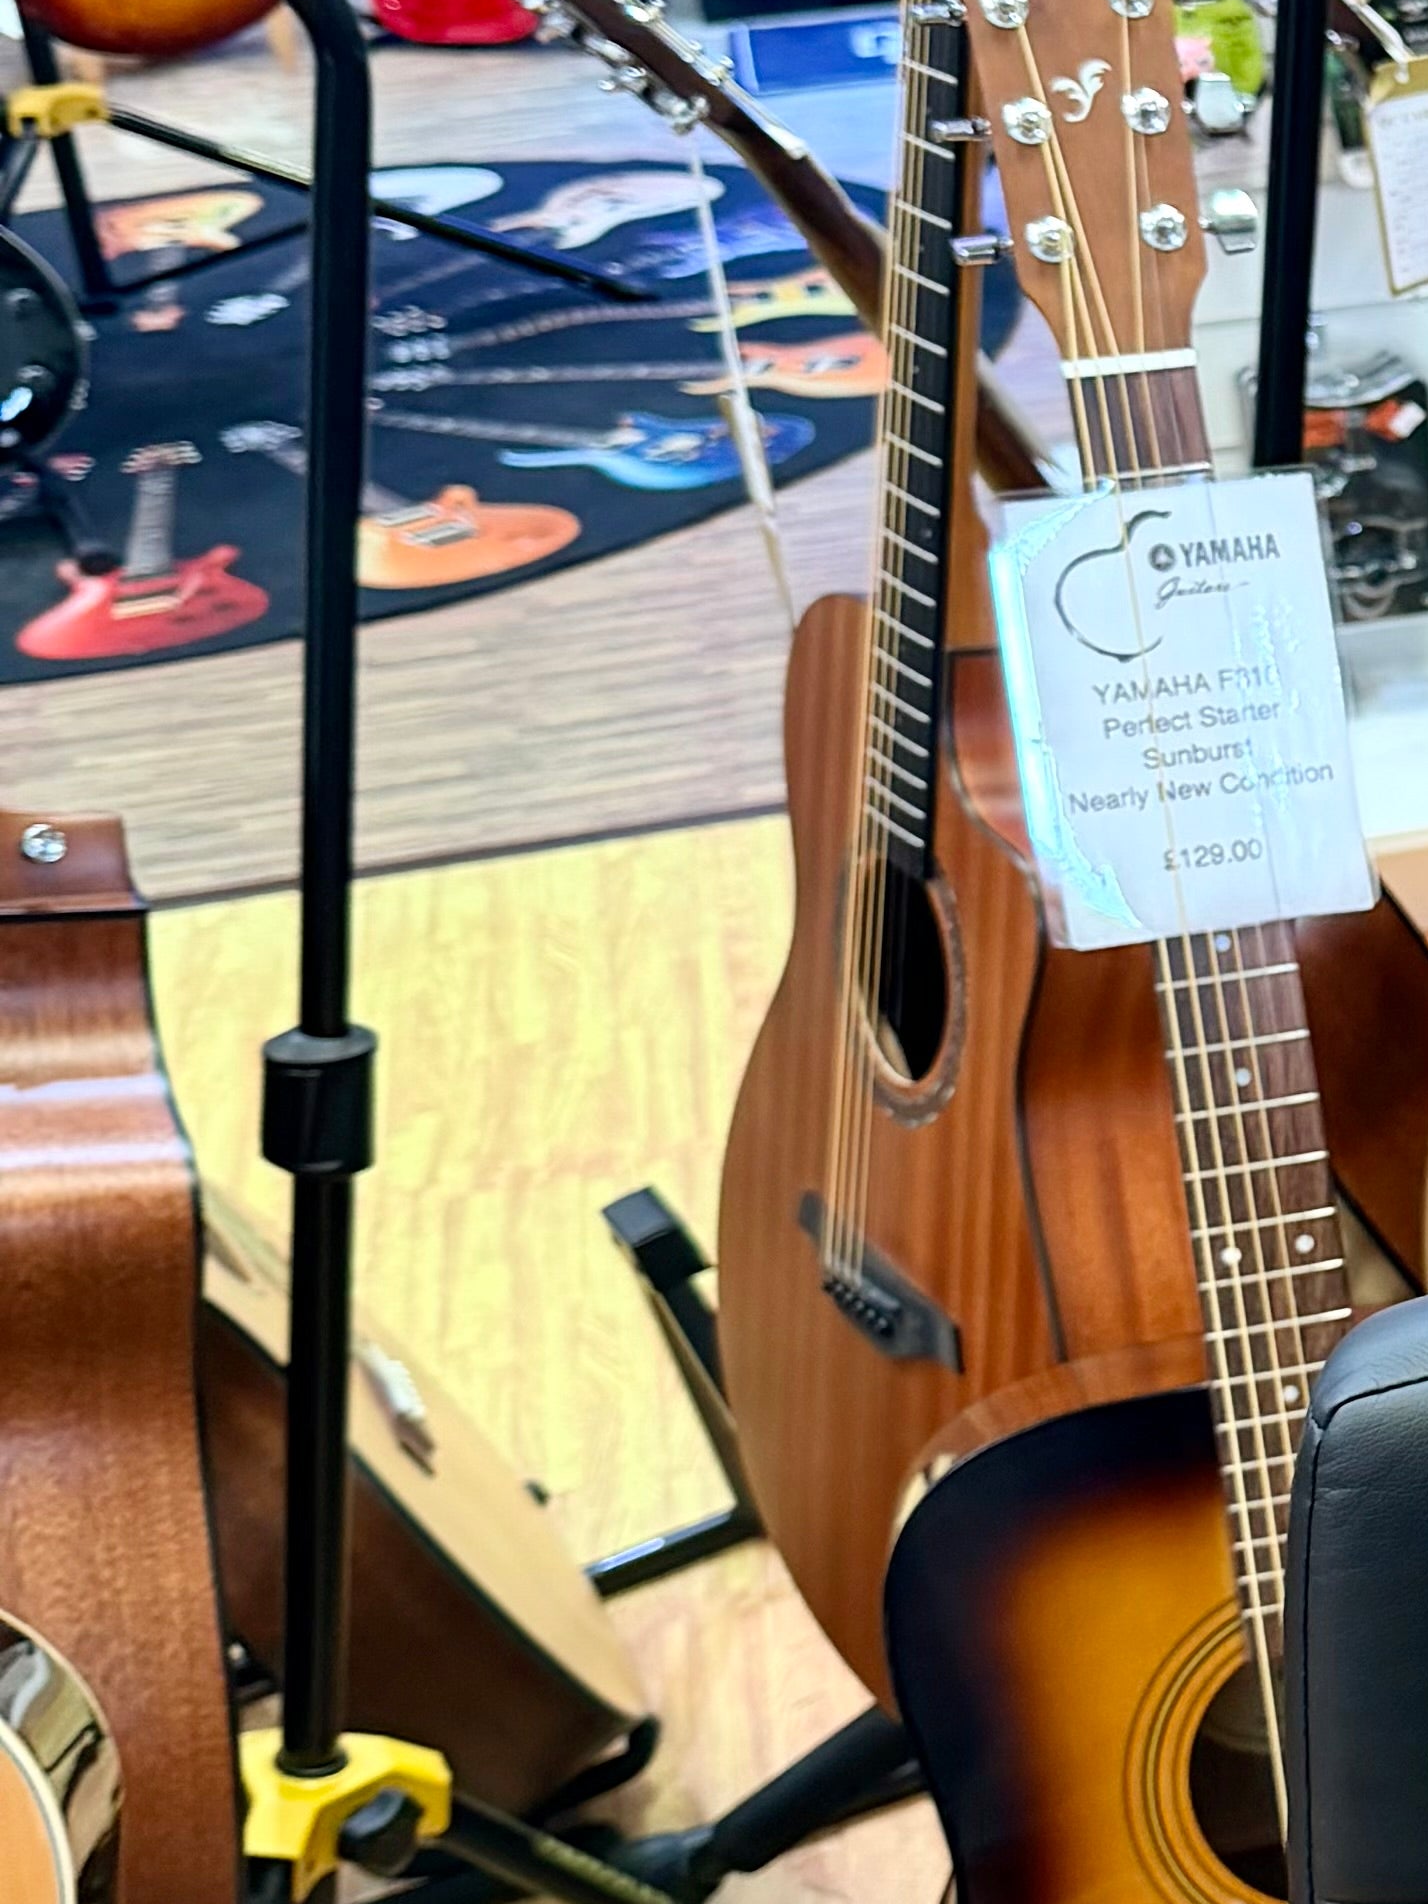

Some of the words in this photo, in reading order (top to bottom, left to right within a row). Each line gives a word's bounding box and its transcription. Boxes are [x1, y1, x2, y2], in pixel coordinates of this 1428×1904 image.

[1178, 533, 1280, 568] YAMAHA
[1092, 672, 1212, 705] YAMAHA
[1103, 710, 1193, 739] Perfect
[1199, 701, 1281, 729] Starter
[1069, 786, 1149, 815] Nearly
[1157, 780, 1212, 803] New
[1163, 837, 1263, 872] £129.00
